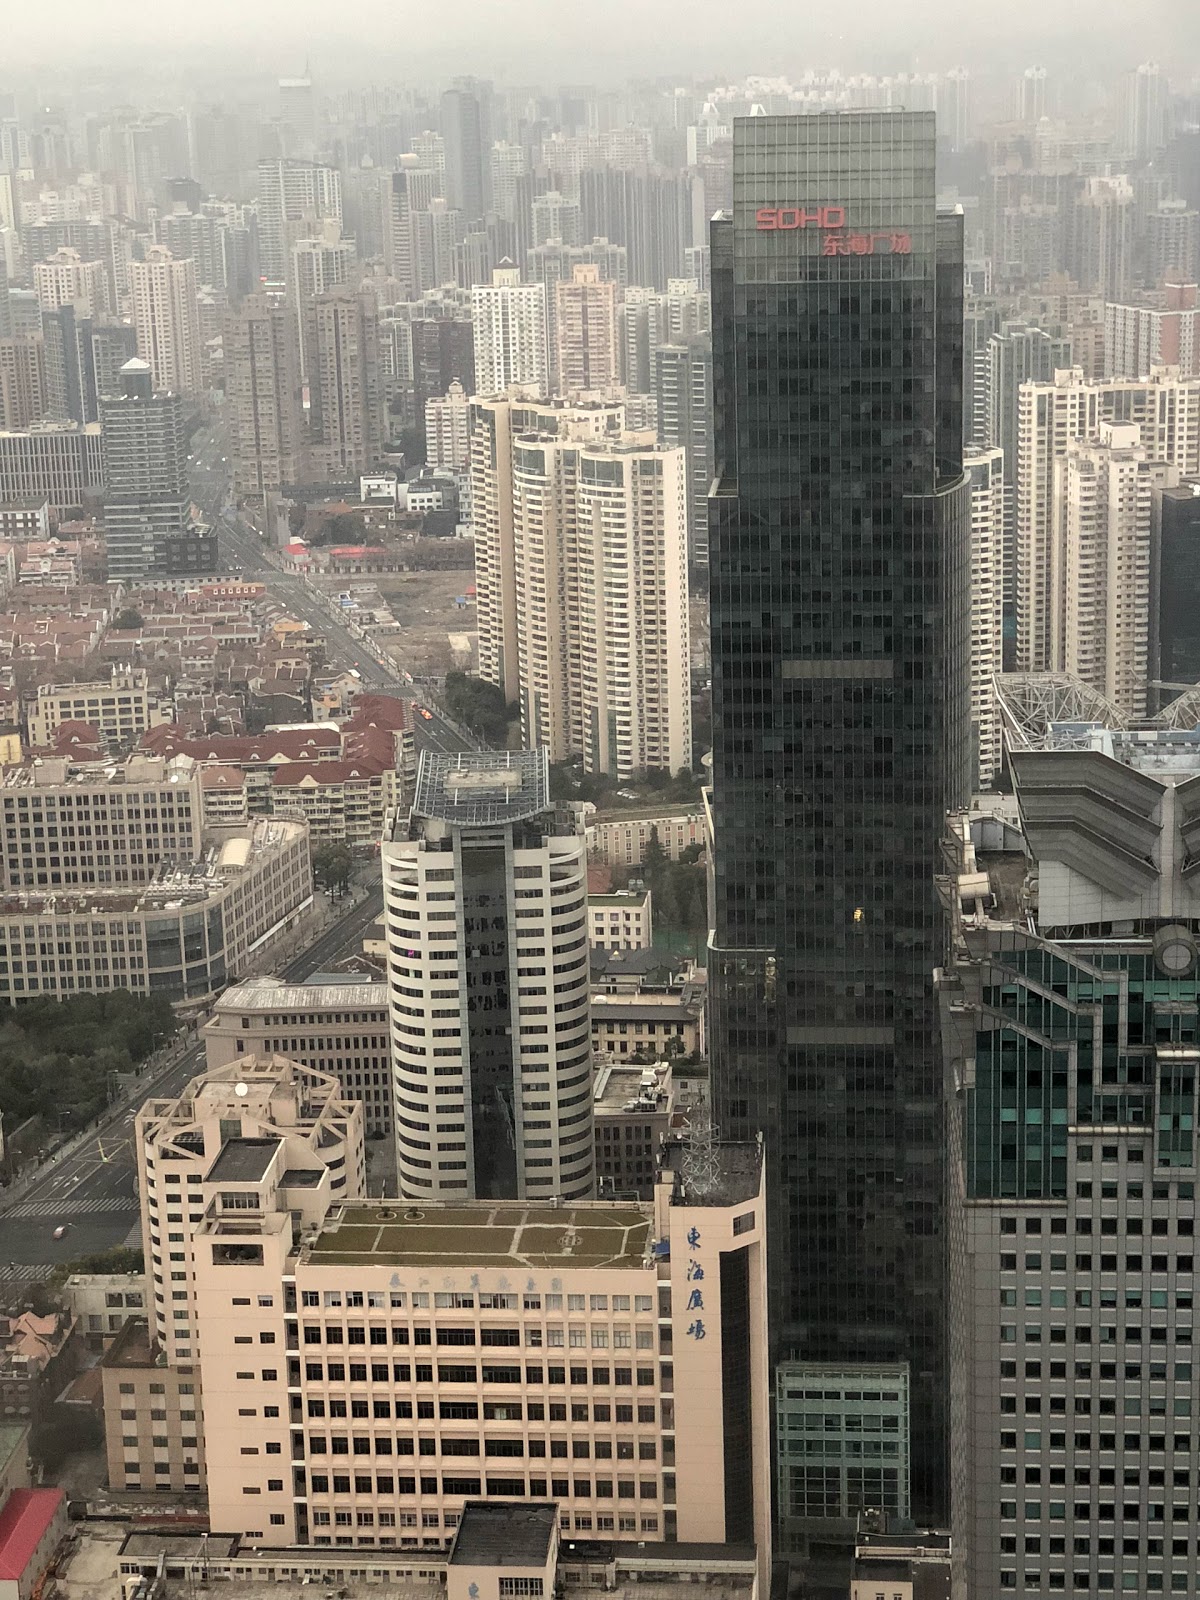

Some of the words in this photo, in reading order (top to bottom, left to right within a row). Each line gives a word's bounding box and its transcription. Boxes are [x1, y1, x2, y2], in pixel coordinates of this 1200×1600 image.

[756, 207, 845, 230] SOHO
[822, 233, 912, 256] 东海广场
